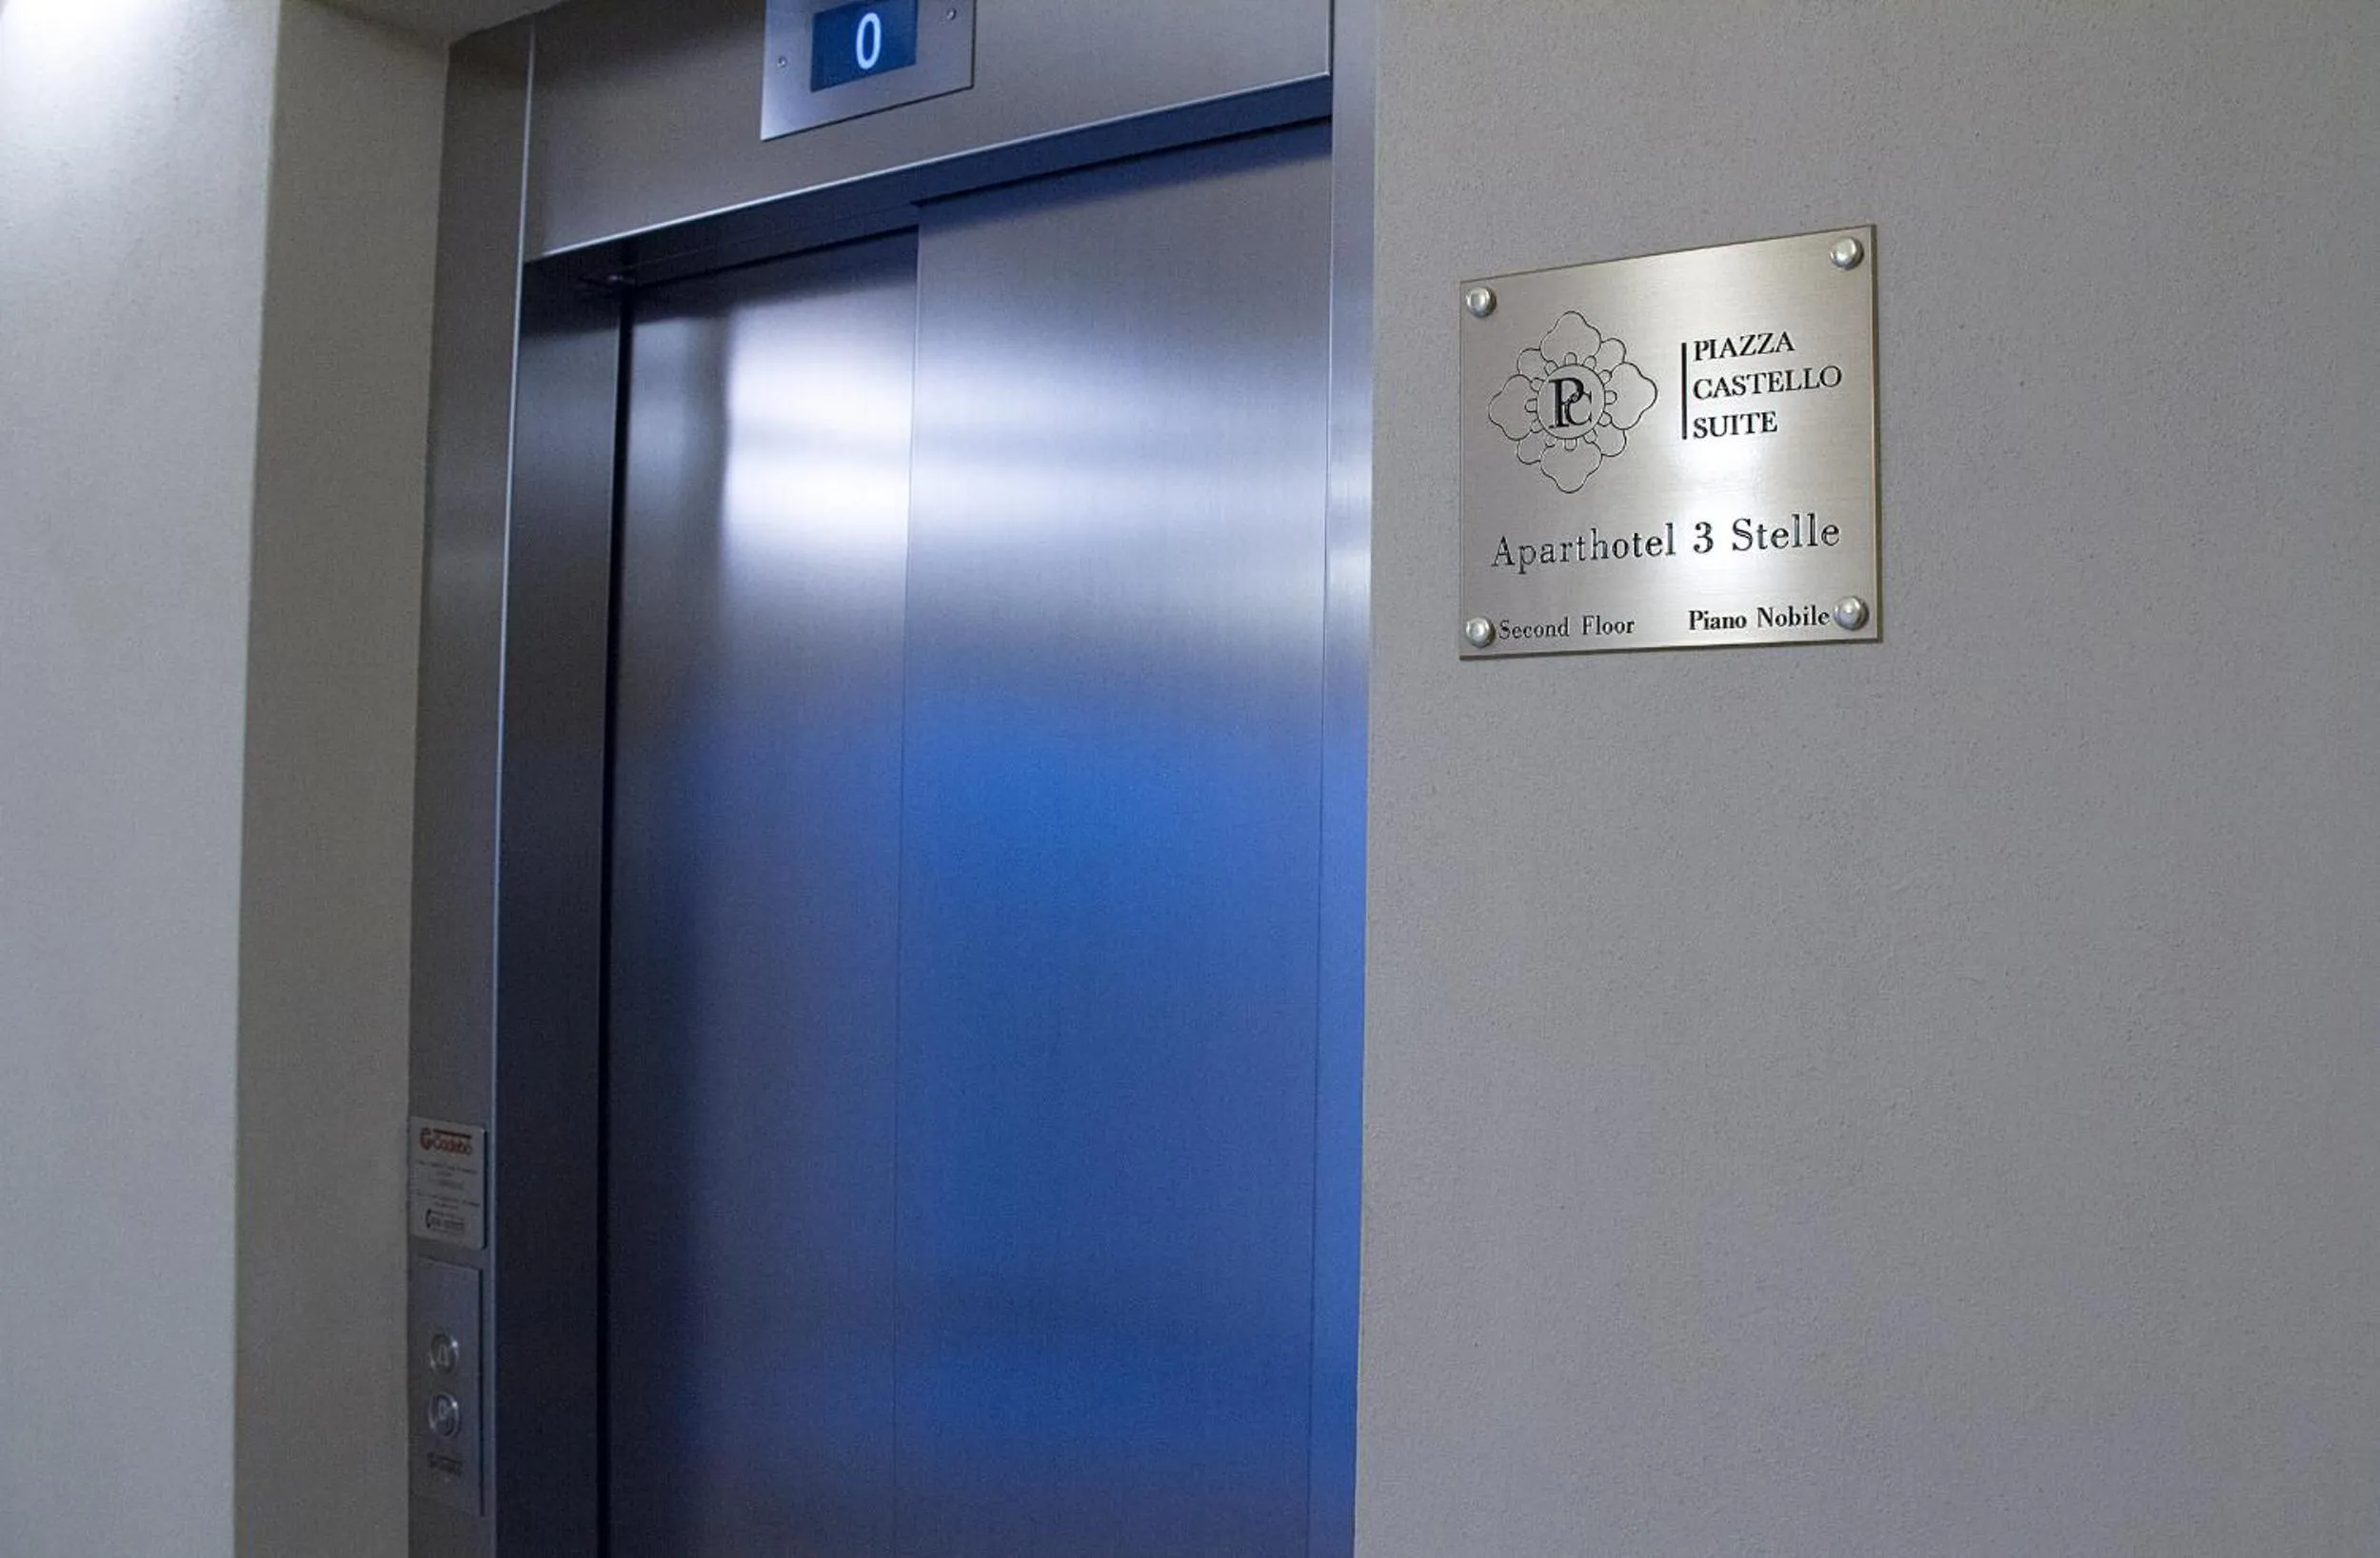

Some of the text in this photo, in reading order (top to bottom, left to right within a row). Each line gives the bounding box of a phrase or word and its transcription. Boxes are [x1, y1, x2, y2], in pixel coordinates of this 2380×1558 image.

[856, 12, 882, 69] 0
[1694, 331, 1795, 361] PIAZZA
[1693, 365, 1842, 400] CASTELLO
[1693, 411, 1778, 440] SUITE
[1491, 513, 1841, 575] Aparthotel 3 Stelle
[1498, 615, 1636, 641] Second Floor
[1689, 604, 1830, 632] Piano Nobile
